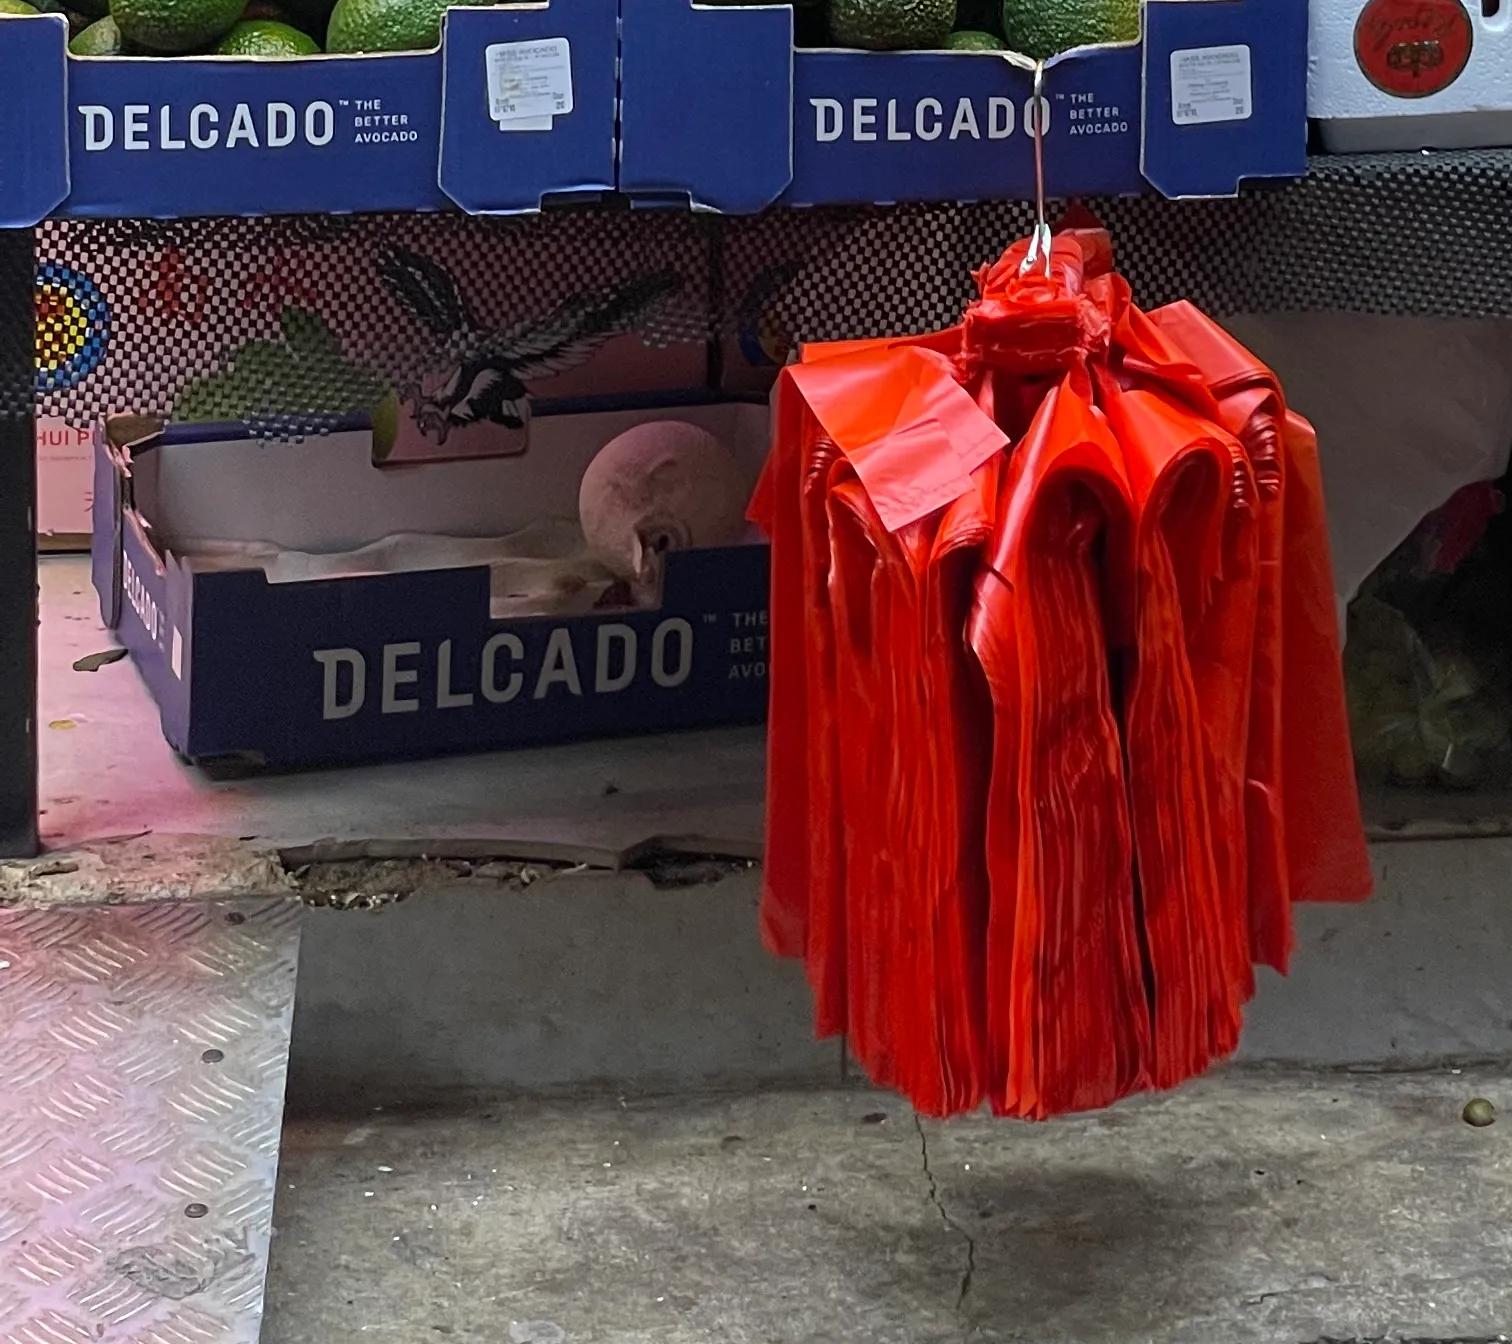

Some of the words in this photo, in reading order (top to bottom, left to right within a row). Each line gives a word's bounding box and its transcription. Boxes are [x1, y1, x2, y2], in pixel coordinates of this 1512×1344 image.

[354, 99, 382, 111] THE
[1069, 92, 1095, 104] THE
[809, 96, 1051, 142] DELCADO
[1069, 107, 1120, 119] BETTER
[78, 100, 336, 151] DELCADO
[354, 115, 409, 126] BETTER
[1069, 121, 1129, 135] AVOCADO
[354, 130, 418, 144] AVOCADO
[313, 616, 694, 720] DELCADO
